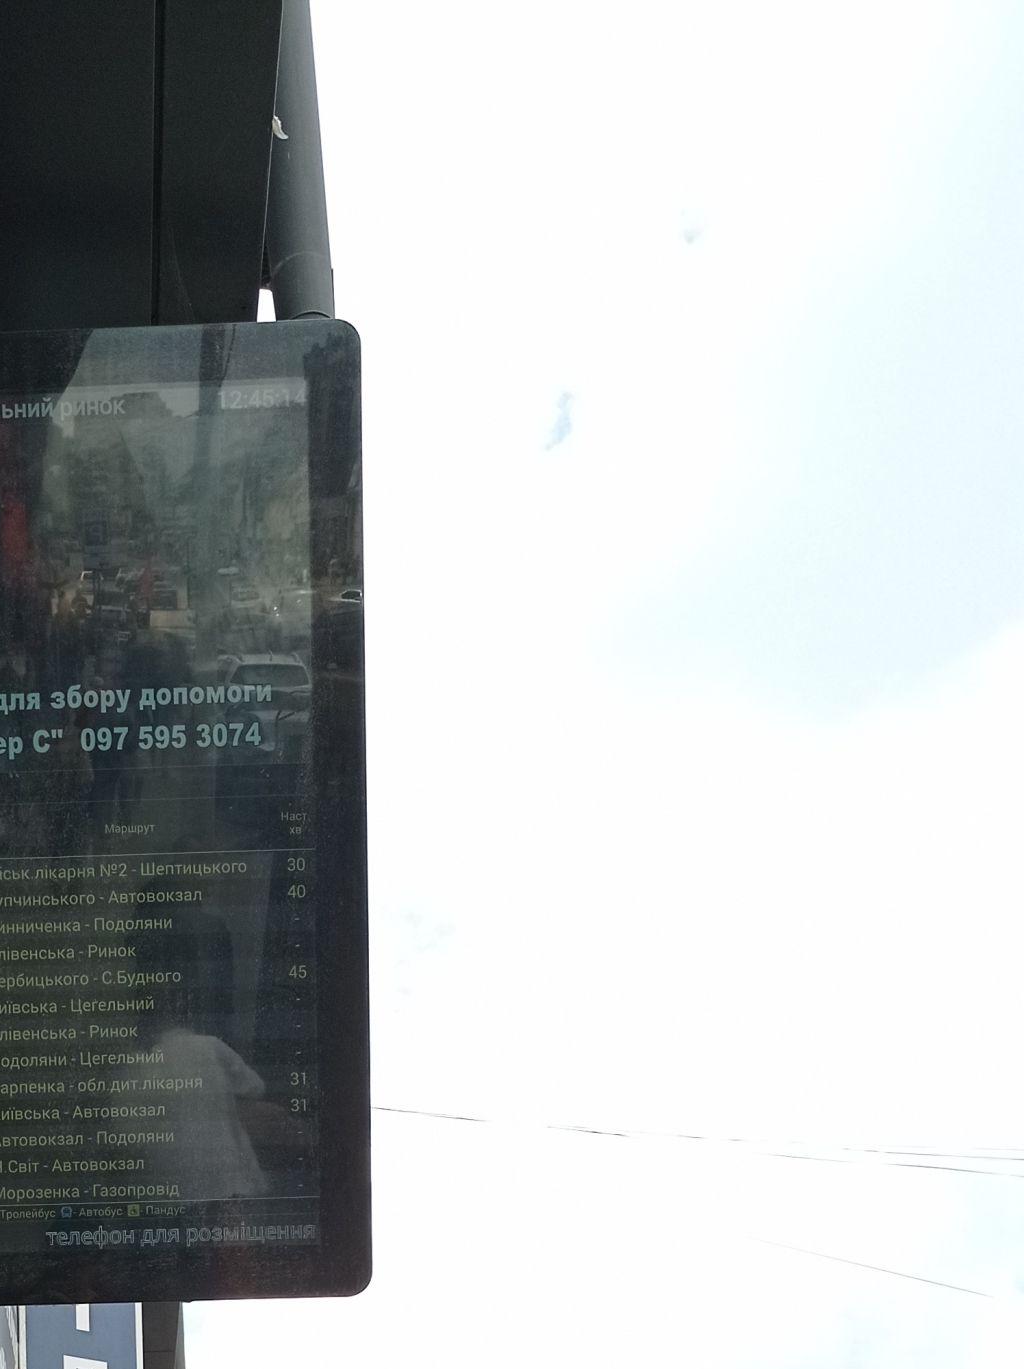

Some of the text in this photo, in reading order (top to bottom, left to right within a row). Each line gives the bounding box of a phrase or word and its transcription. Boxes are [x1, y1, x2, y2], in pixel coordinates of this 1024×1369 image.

[60, 399, 125, 421] ринок
[51, 684, 131, 713] збору
[139, 683, 273, 711] допомоги
[32, 728, 63, 754] С"
[80, 727, 129, 752] 097
[138, 725, 187, 750] 595
[195, 722, 262, 748] 3074
[104, 823, 156, 836] Маршрут
[289, 826, 302, 835] хв
[140, 860, 247, 877] Шептицького
[287, 857, 306, 872] 30
[108, 889, 202, 905] Автовокзал
[287, 884, 306, 898] 40
[94, 917, 173, 932] Подоляни
[87, 944, 137, 958] Ринок
[101, 970, 182, 987] С.Будного
[289, 964, 307, 979] 45
[89, 1025, 138, 1038] Ринок
[80, 1049, 164, 1068] Цегельний
[290, 1072, 306, 1086] 31
[72, 1104, 166, 1119] Автовокзал
[290, 1098, 307, 1112] 31
[96, 1130, 174, 1146] Подоляни
[52, 1158, 145, 1173] Автовокзал
[93, 1181, 180, 1198] Газопровід
[0, 1205, 186, 1220] Тролейбус Автобус Пандус
[46, 1221, 316, 1249] телефон для розміщення
